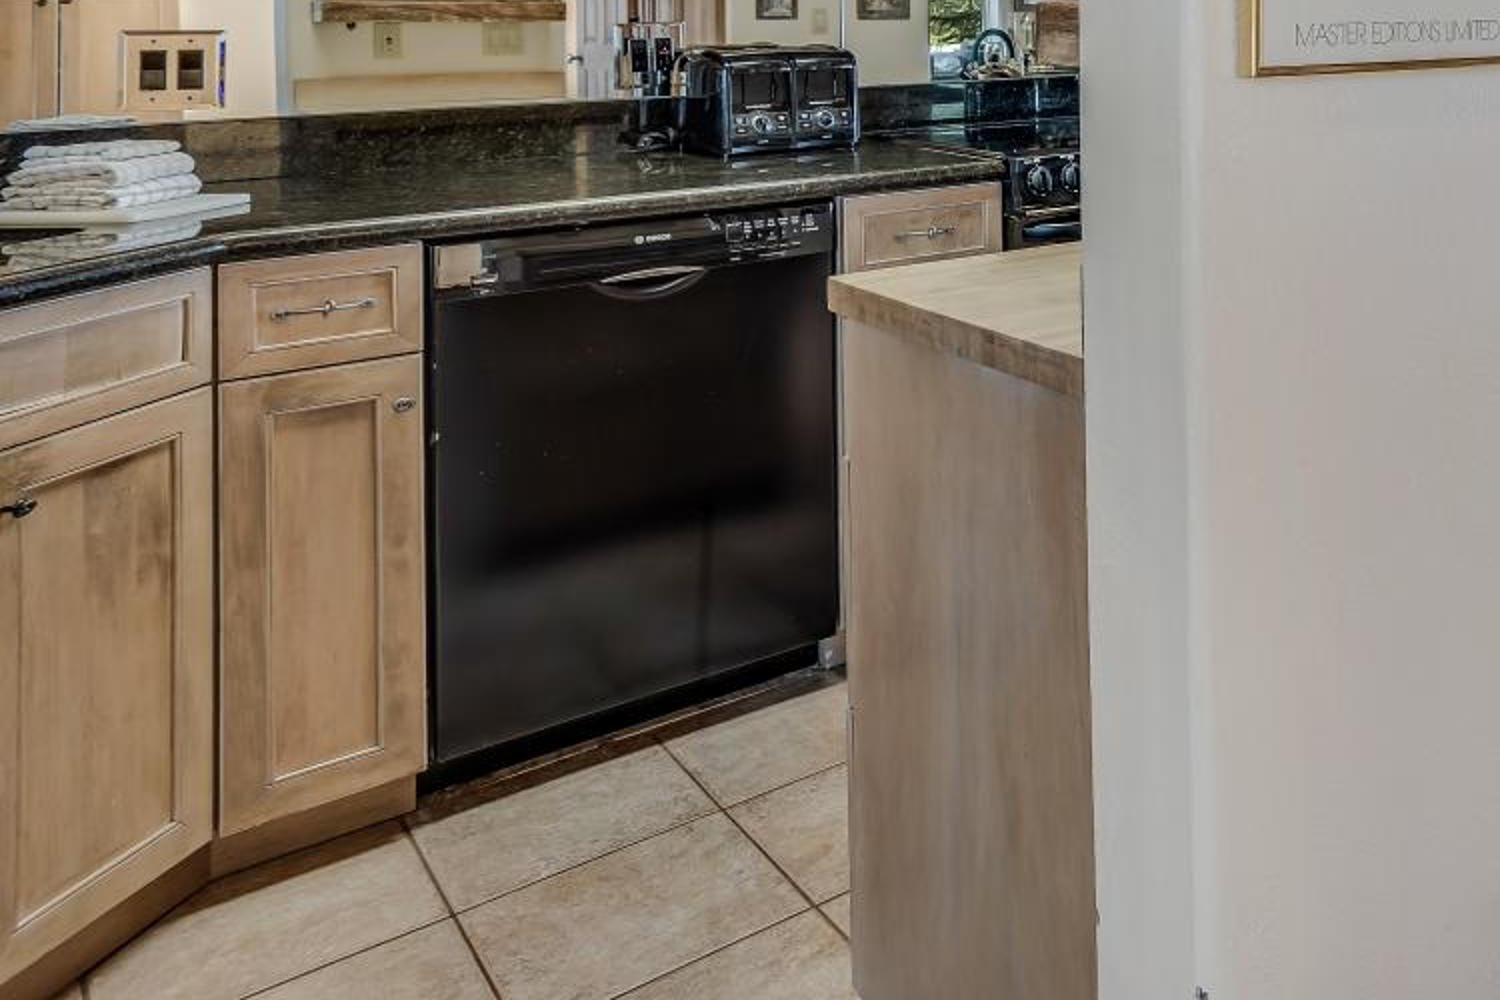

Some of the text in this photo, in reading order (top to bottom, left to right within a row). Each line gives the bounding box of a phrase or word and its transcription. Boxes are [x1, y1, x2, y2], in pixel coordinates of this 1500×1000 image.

[1295, 21, 1367, 47] MASTER
[1371, 19, 1441, 45] EDITIONS
[1446, 18, 1500, 43] LIMITED
